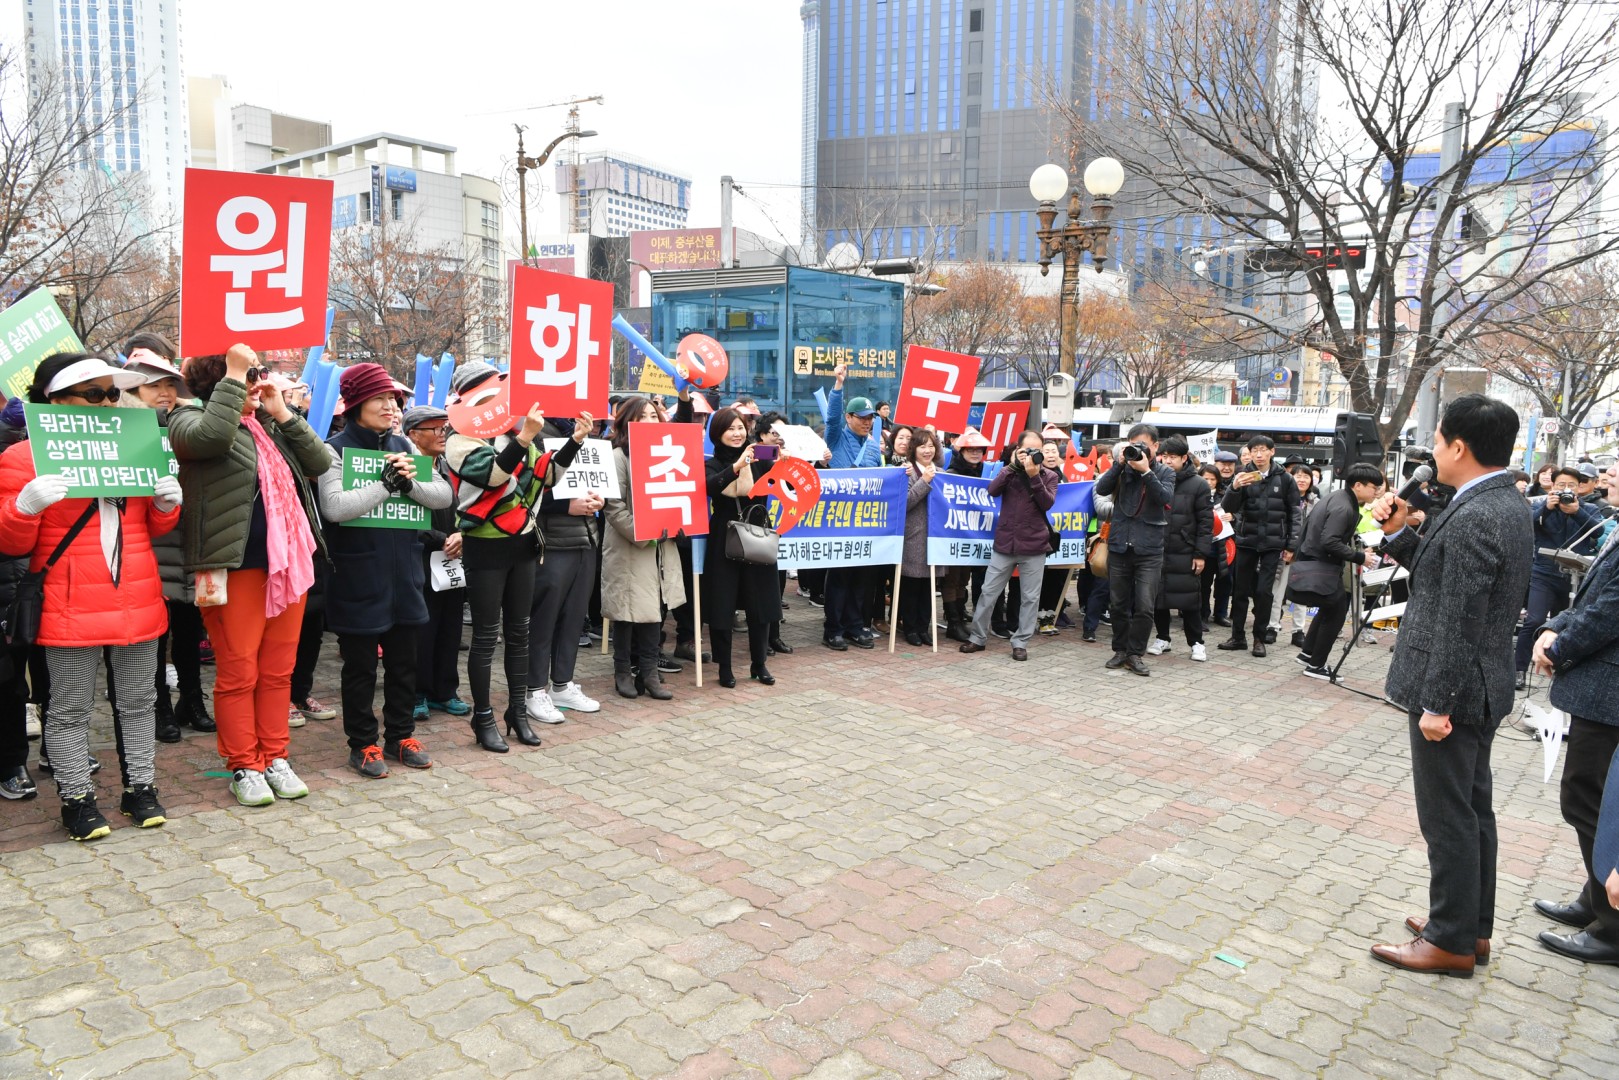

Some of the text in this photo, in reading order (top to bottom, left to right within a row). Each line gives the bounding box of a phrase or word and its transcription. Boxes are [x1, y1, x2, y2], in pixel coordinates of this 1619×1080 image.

[540, 244, 575, 257] 현대건설
[650, 234, 715, 250] 이제, 중부산을
[210, 196, 307, 332] 원
[7, 317, 43, 354] 숨쉬게
[35, 305, 62, 333] 하고
[525, 293, 599, 400] 화
[814, 346, 896, 368] 도시철도 해운대역
[911, 359, 962, 418] 구
[38, 413, 122, 434] 뭐라카노?
[46, 440, 120, 461] 상업개발
[351, 456, 386, 474] 뭐라카
[59, 466, 159, 487] 절대 안된다!
[565, 470, 609, 489] 금지한다
[645, 433, 696, 527] 촉
[788, 465, 813, 493] 공원화!
[943, 482, 997, 508] 부산시여!
[386, 502, 424, 522] 안된다!
[826, 501, 854, 528] 주민의
[854, 501, 888, 528] 품으로!!
[944, 509, 995, 532] 시민에게
[777, 540, 873, 562] 도자해운대구협의회
